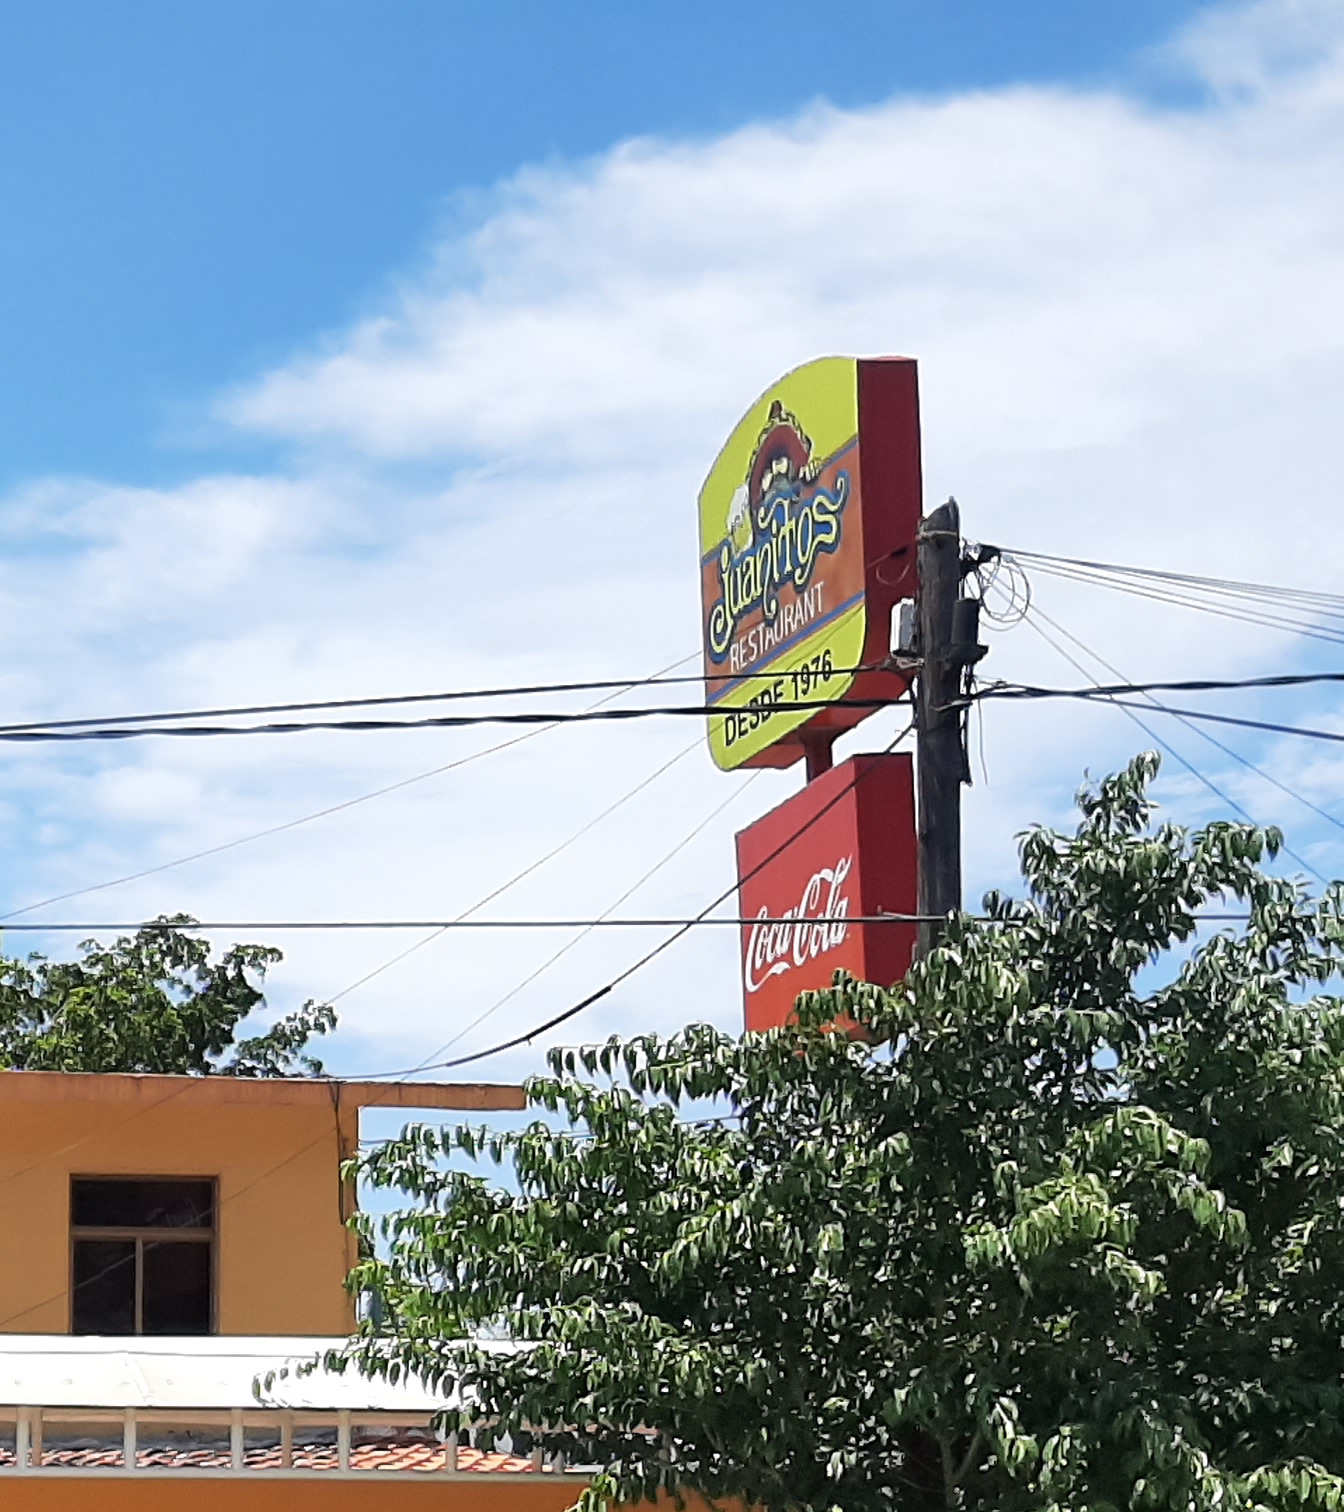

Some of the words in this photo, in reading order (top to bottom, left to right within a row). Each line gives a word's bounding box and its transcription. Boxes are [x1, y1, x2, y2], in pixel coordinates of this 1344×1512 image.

[729, 580, 825, 674] RESTAURANT
[724, 678, 785, 747] DESDE
[790, 648, 833, 701] 1976
